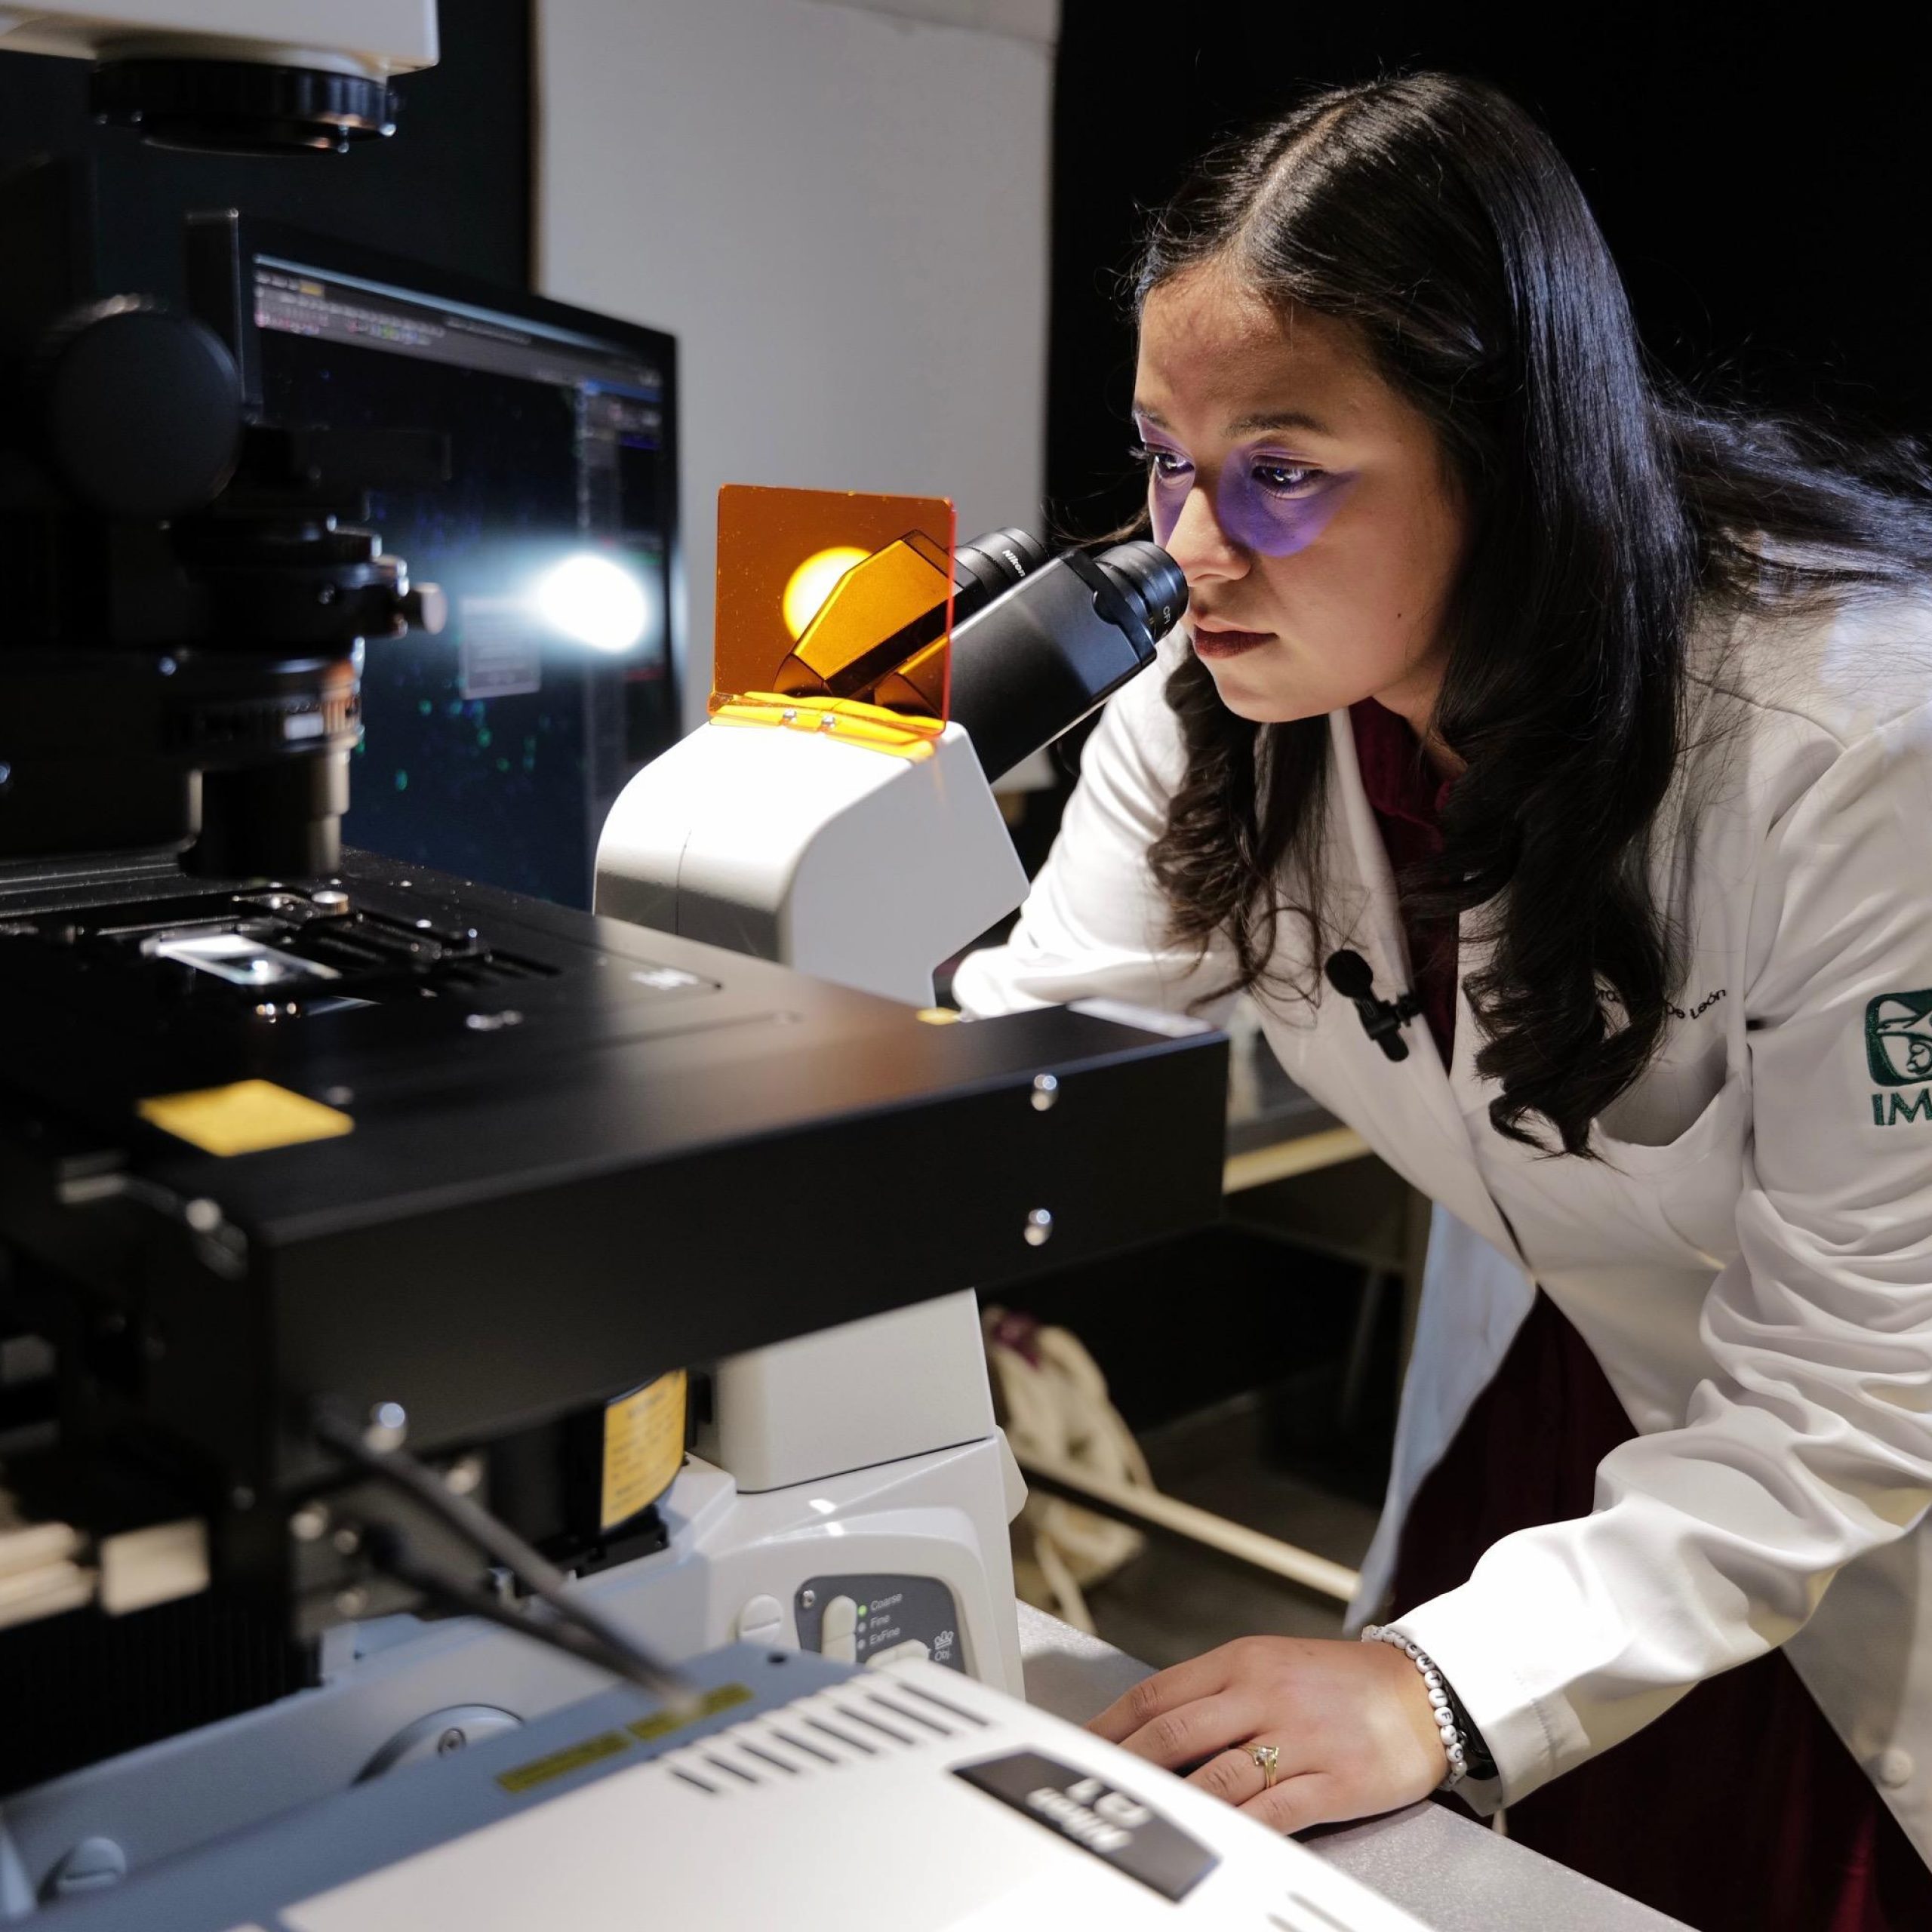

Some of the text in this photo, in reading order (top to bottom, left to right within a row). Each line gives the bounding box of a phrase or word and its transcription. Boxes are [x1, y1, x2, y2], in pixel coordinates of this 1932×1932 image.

[1002, 549, 1026, 577] Nikon
[1690, 989, 1726, 1020] León
[870, 1592, 903, 1611] Coarse
[870, 1615, 891, 1629] Fine
[869, 1627, 900, 1645] ExFine
